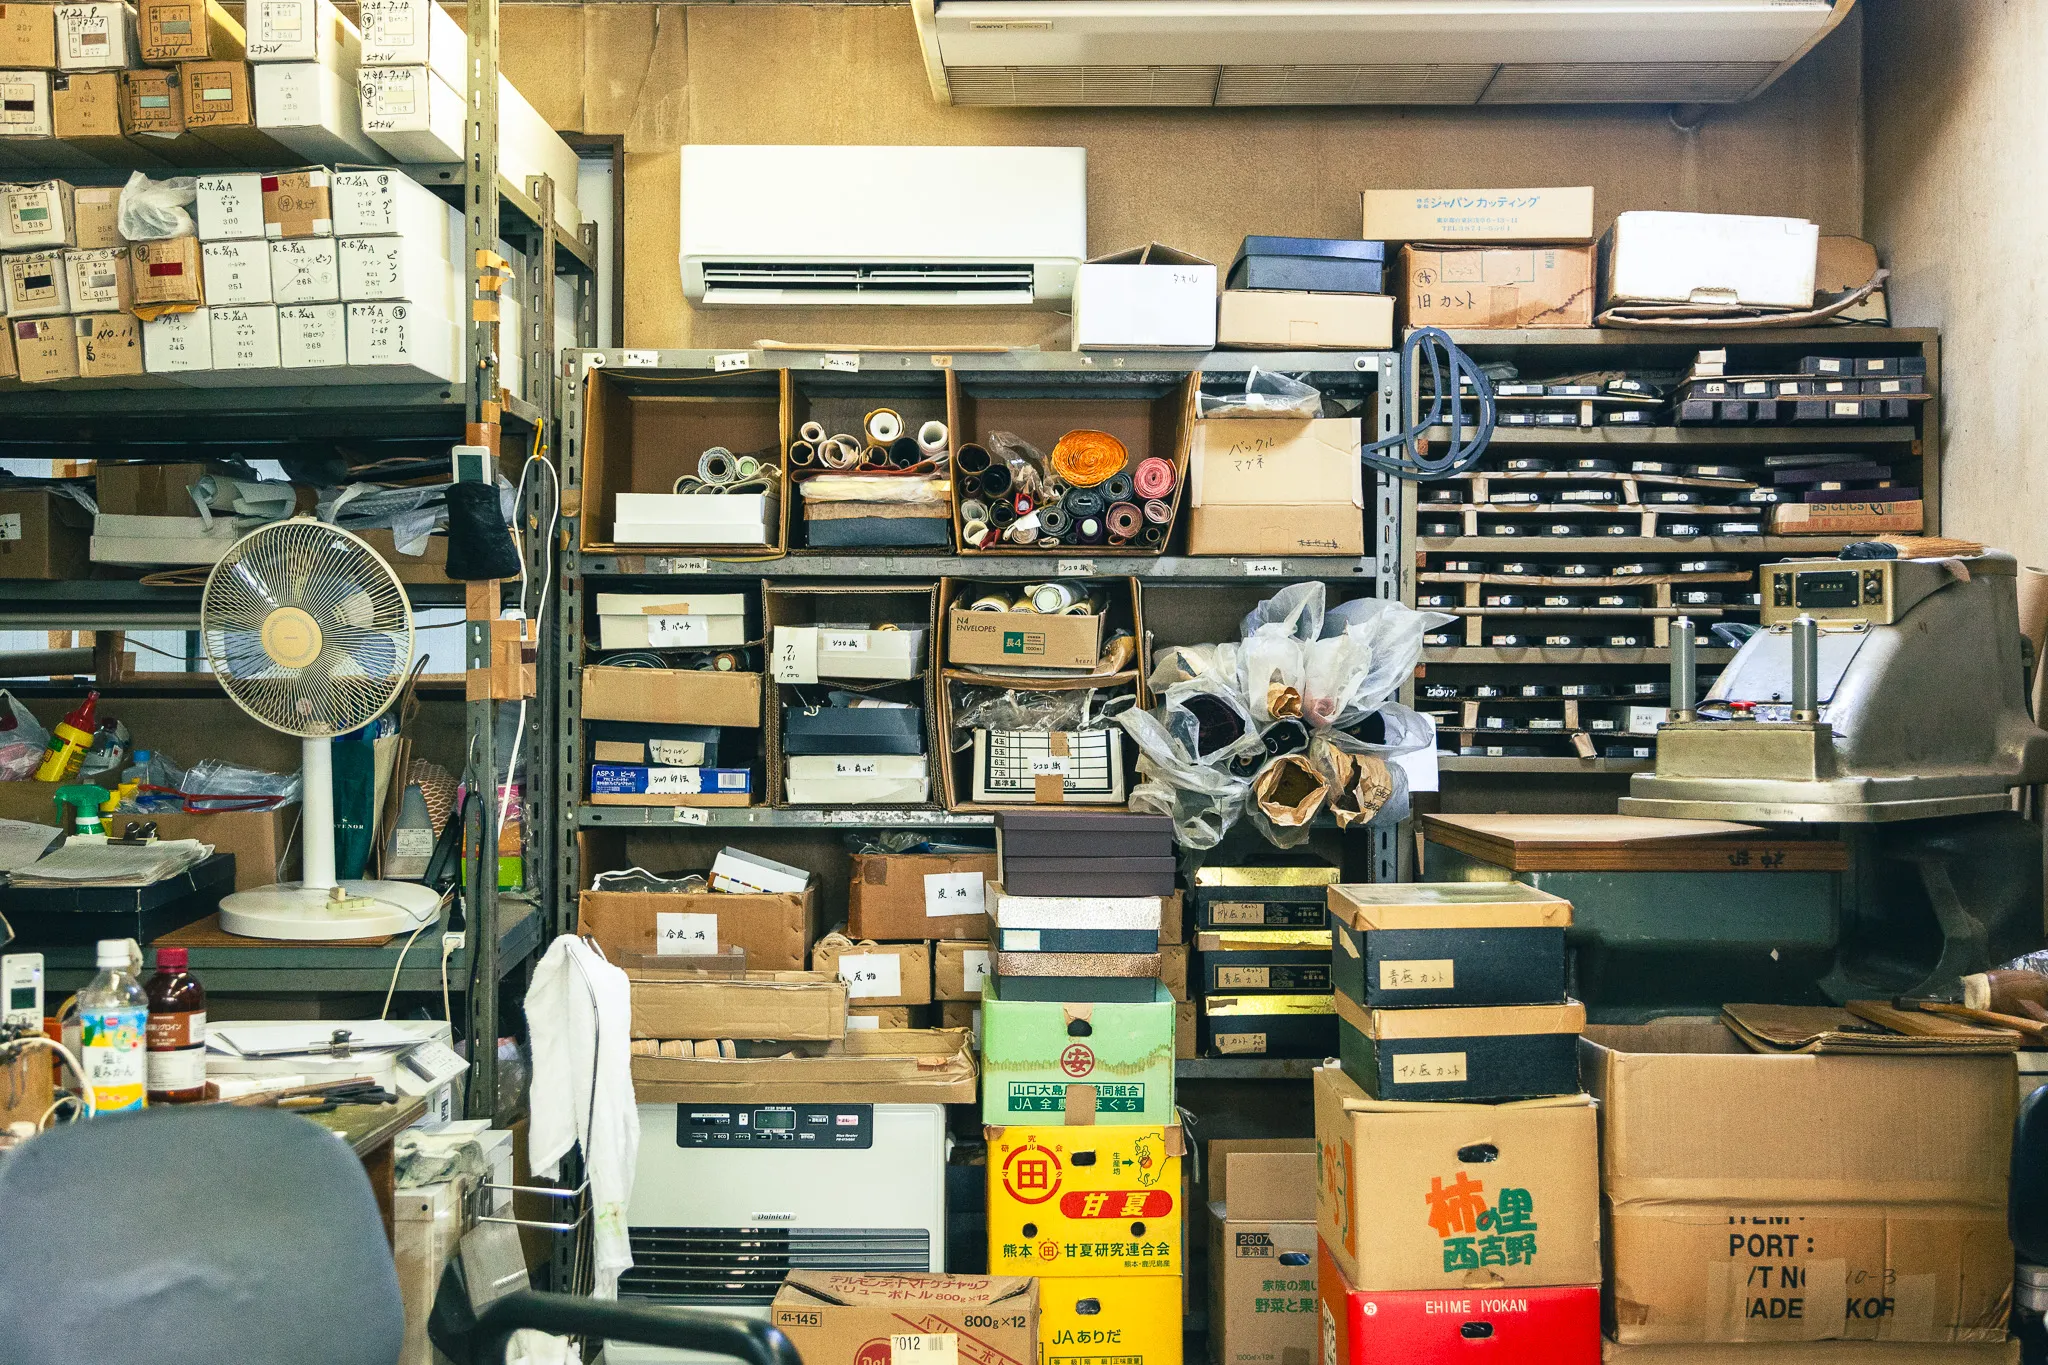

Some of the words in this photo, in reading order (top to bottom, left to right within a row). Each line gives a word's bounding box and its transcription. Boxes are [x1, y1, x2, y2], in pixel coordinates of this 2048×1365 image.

[146, 46, 180, 57] エナメル
[284, 72, 292, 80] A
[83, 81, 92, 90] A
[1431, 197, 1474, 209] ジャパン
[1476, 196, 1541, 208] カッティング
[1173, 273, 1198, 284] タオル
[1228, 437, 1275, 456] バックル
[956, 617, 969, 625] N4
[956, 625, 997, 633] ENVELOPES
[1006, 638, 1022, 648] 長4
[994, 748, 1006, 756] 5玉
[994, 769, 1006, 777] 7玉
[1014, 1084, 1139, 1097] 山口大島協同組合
[1112, 1152, 1121, 1176] 生産地
[1017, 1160, 1048, 1190] 田
[1425, 1171, 1537, 1238] 柿の里
[1003, 1243, 1033, 1259] 熊本
[1064, 1241, 1171, 1258] 甘夏研究連合会
[1443, 1234, 1538, 1273] 西吉野
[1255, 1297, 1318, 1314] 野菜と果
[1425, 1301, 1471, 1314] EHIME
[1481, 1299, 1528, 1313] IYOKAN
[1746, 1297, 1803, 1320] ADE
[780, 1313, 818, 1325] 41-145
[1052, 1328, 1121, 1345] JAありだ
